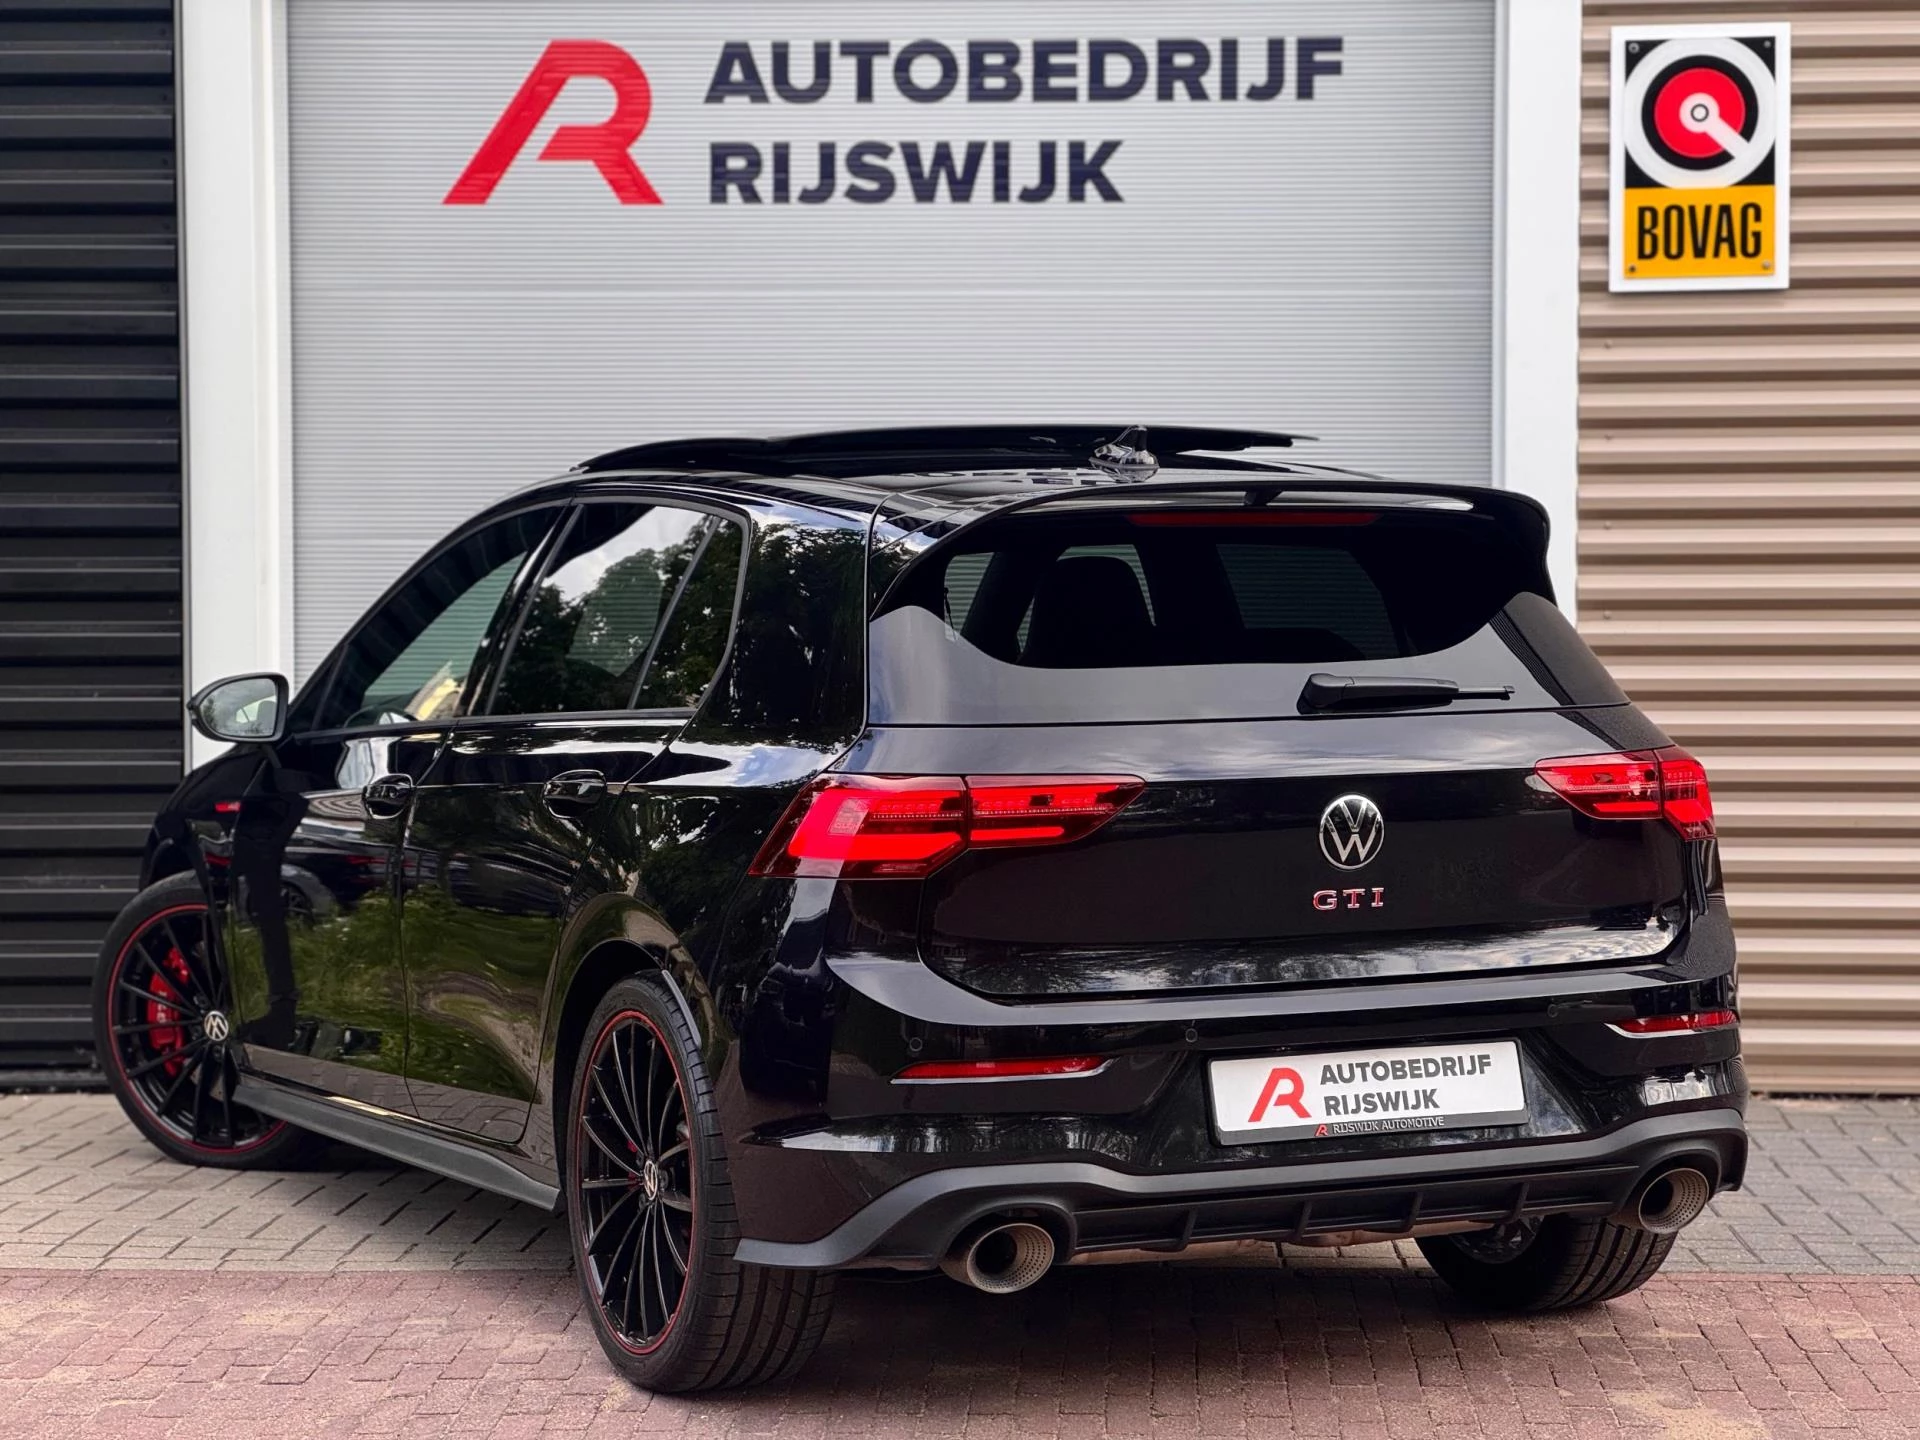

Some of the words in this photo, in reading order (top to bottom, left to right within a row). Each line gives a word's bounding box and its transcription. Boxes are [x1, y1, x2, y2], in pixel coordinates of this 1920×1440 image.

[705, 37, 1344, 103] AUTOBEDRIJF
[710, 140, 1123, 204] RIJSWIJK
[1637, 202, 1762, 260] BOVAG
[1312, 887, 1385, 911] GTI
[1320, 1054, 1492, 1085] AUTOBEDRIJF
[1323, 1088, 1440, 1116] RIJSWIJK
[1333, 1120, 1379, 1134] RIJSWIJK
[1382, 1116, 1445, 1130] AUTOMOTIVE
